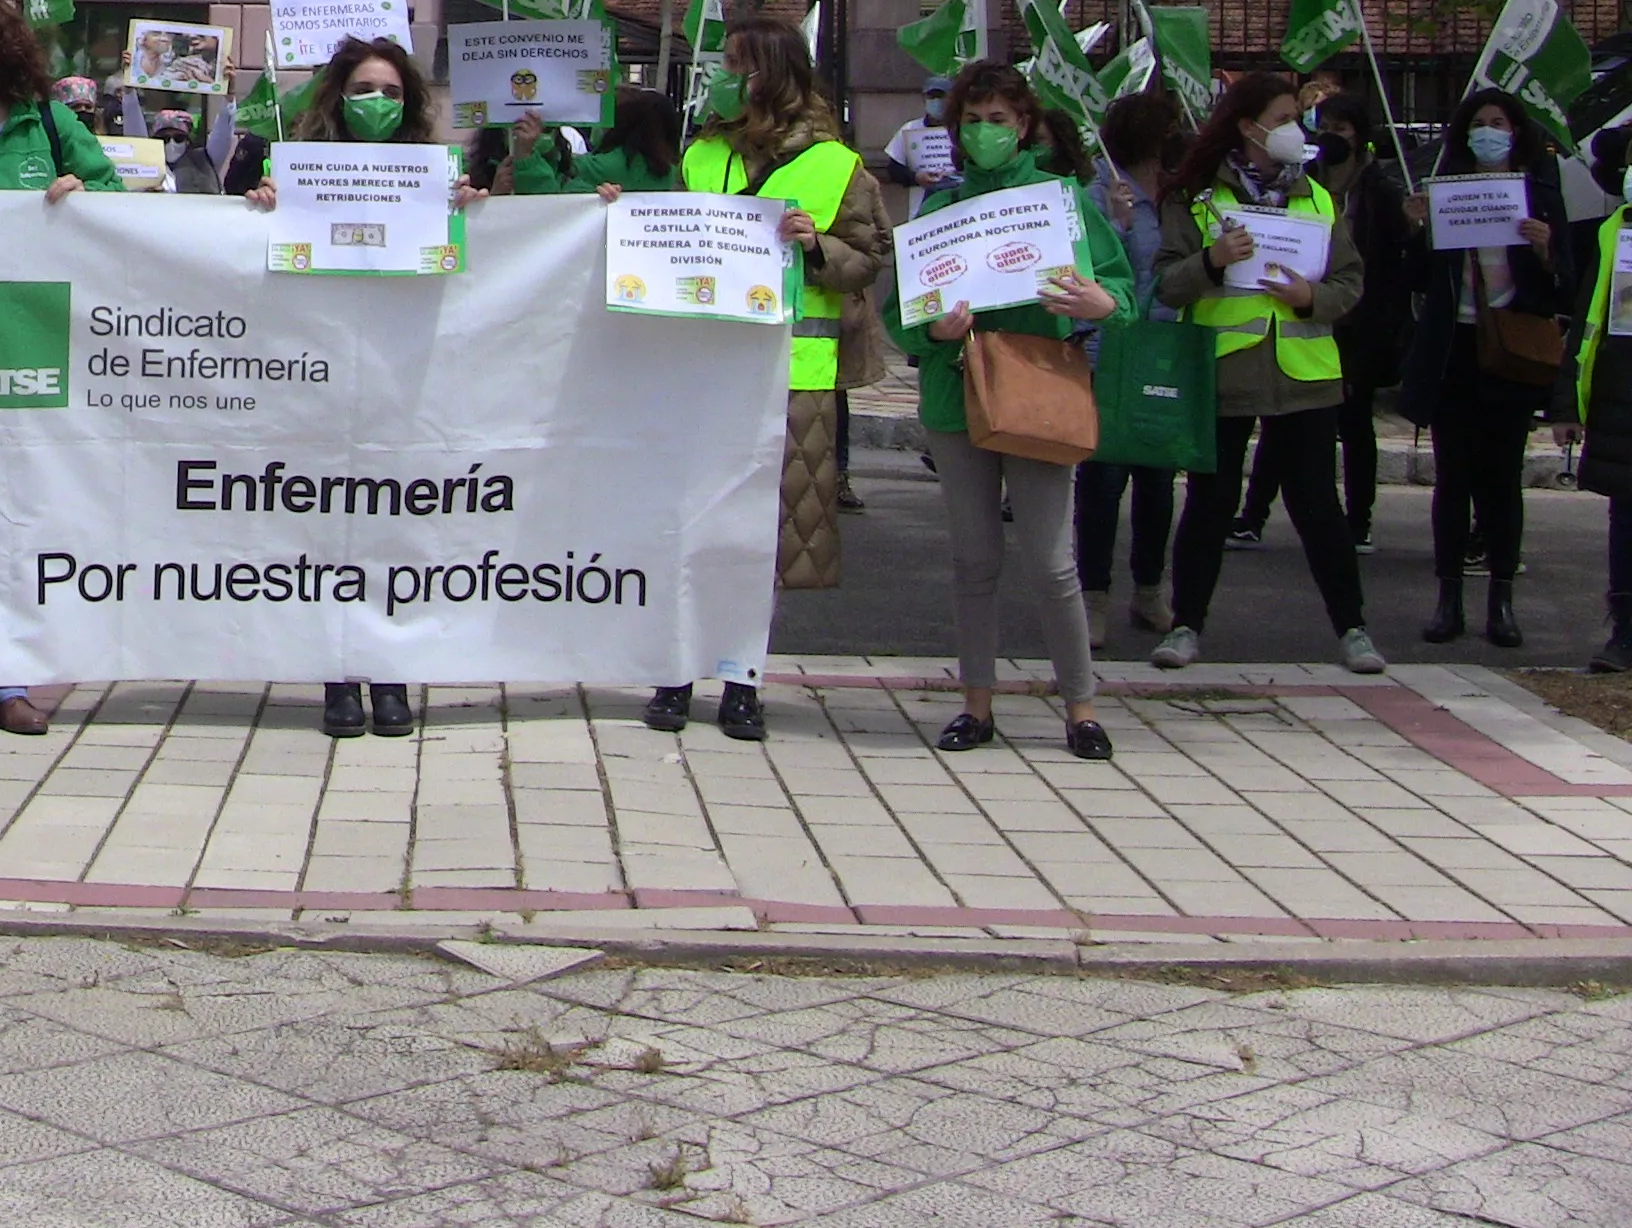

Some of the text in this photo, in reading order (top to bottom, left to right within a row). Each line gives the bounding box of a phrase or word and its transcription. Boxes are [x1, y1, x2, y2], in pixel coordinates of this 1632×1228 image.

[277, 3, 375, 17] LAS ENFERMERAS
[279, 17, 388, 31] SOMOS SANITARIOS
[465, 33, 585, 47] ESTE CONVENIO ME
[462, 47, 588, 62] DEJA SIN DERECHOS
[290, 163, 429, 174] QUIEN CUIDA A NUESTROS
[298, 178, 421, 189] MAYORES MERECE MAS
[316, 193, 401, 203] RETRIBUCIONES
[1482, 192, 1493, 200] TE
[631, 208, 762, 222] ENFERMERA JUNTA DE
[644, 224, 700, 233] CASTILLA
[704, 224, 712, 233] Y
[908, 203, 1049, 247] ENFERMERA DE OFERTA
[985, 219, 1051, 236] NOCTURNA
[620, 239, 771, 256] ENFERMERA DE SEGUNDA
[993, 246, 1030, 260] super
[670, 255, 722, 265] DIVISIÓN
[925, 257, 957, 277] super
[997, 253, 1035, 269] oferta
[928, 265, 962, 283] oferta
[89, 306, 247, 340] Sindicato
[87, 348, 330, 383] de Enfermería
[1143, 384, 1179, 398] SATSE
[87, 389, 256, 412] Lo que nos une
[176, 459, 514, 516] Enfermería
[36, 550, 647, 616] Por nuestra profesión
